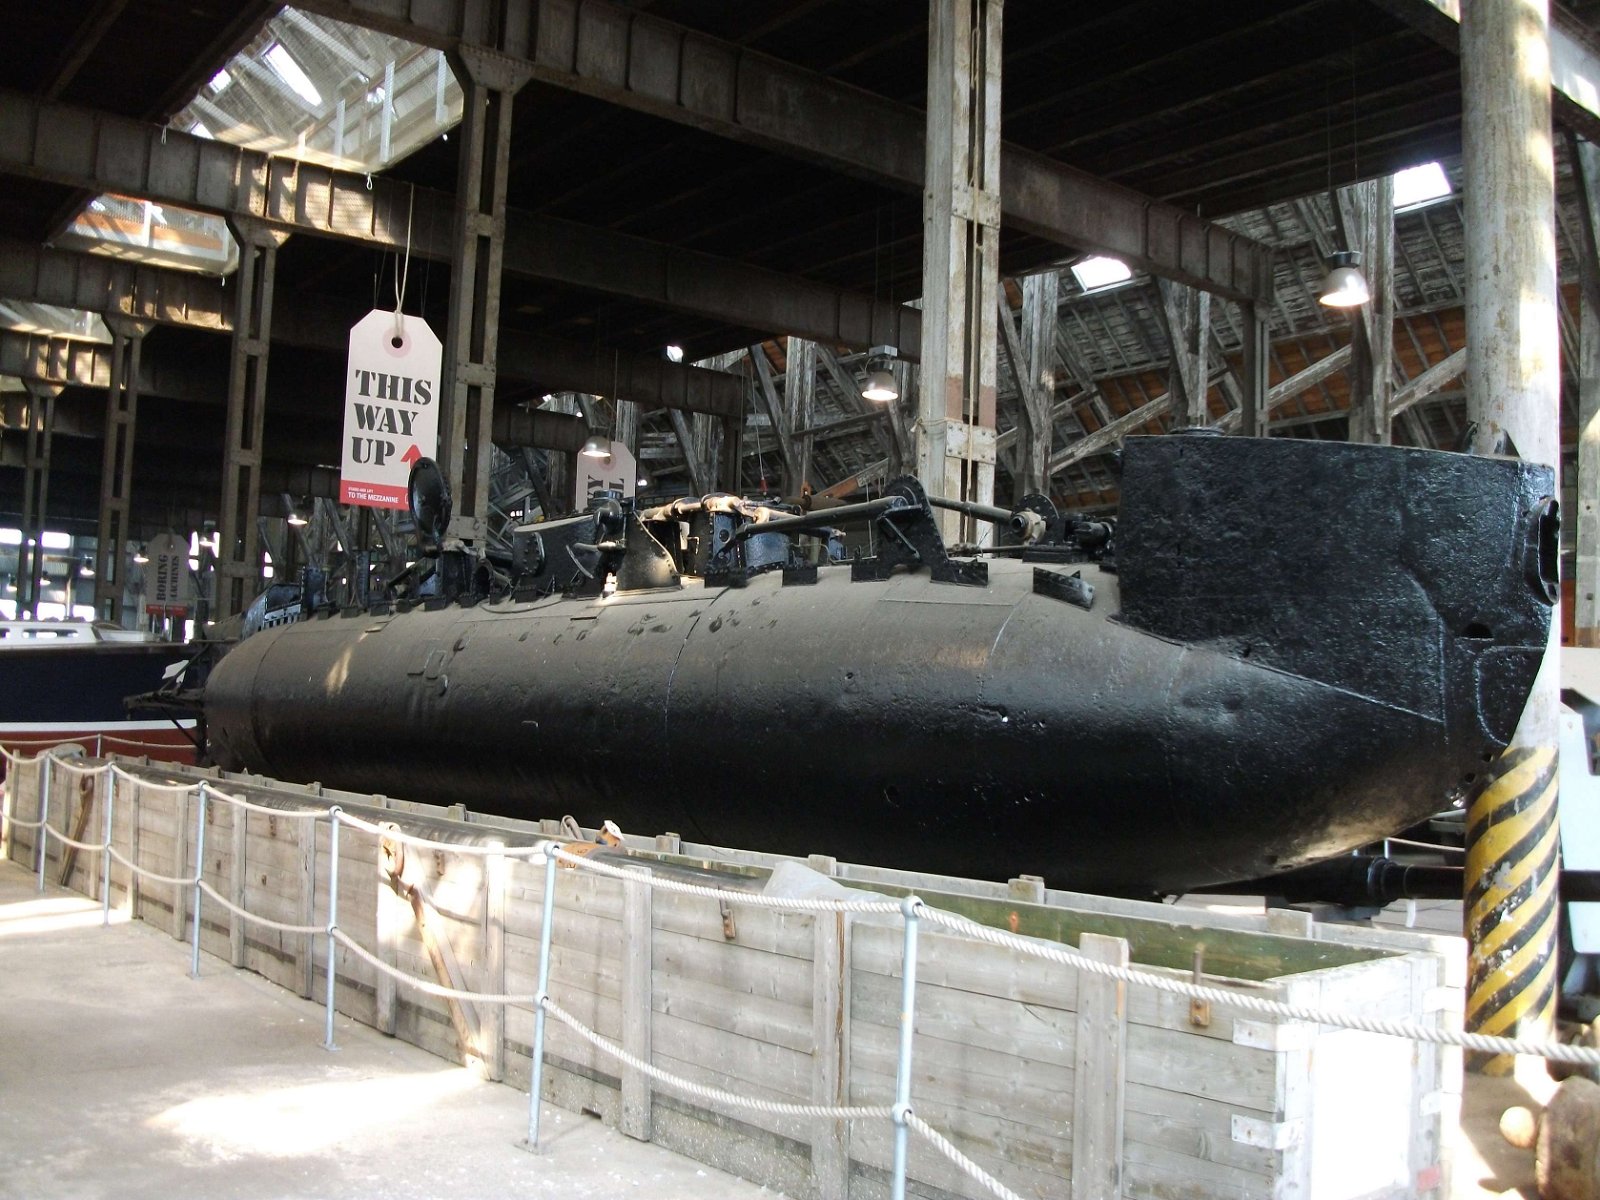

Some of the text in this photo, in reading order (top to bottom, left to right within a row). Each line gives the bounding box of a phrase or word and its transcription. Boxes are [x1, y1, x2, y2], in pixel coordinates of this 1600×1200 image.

[355, 369, 432, 406] THIS
[353, 402, 419, 436] WAY
[351, 436, 396, 466] UP
[348, 491, 399, 504] TO THE MEZZANINE
[156, 553, 168, 601] BORING
